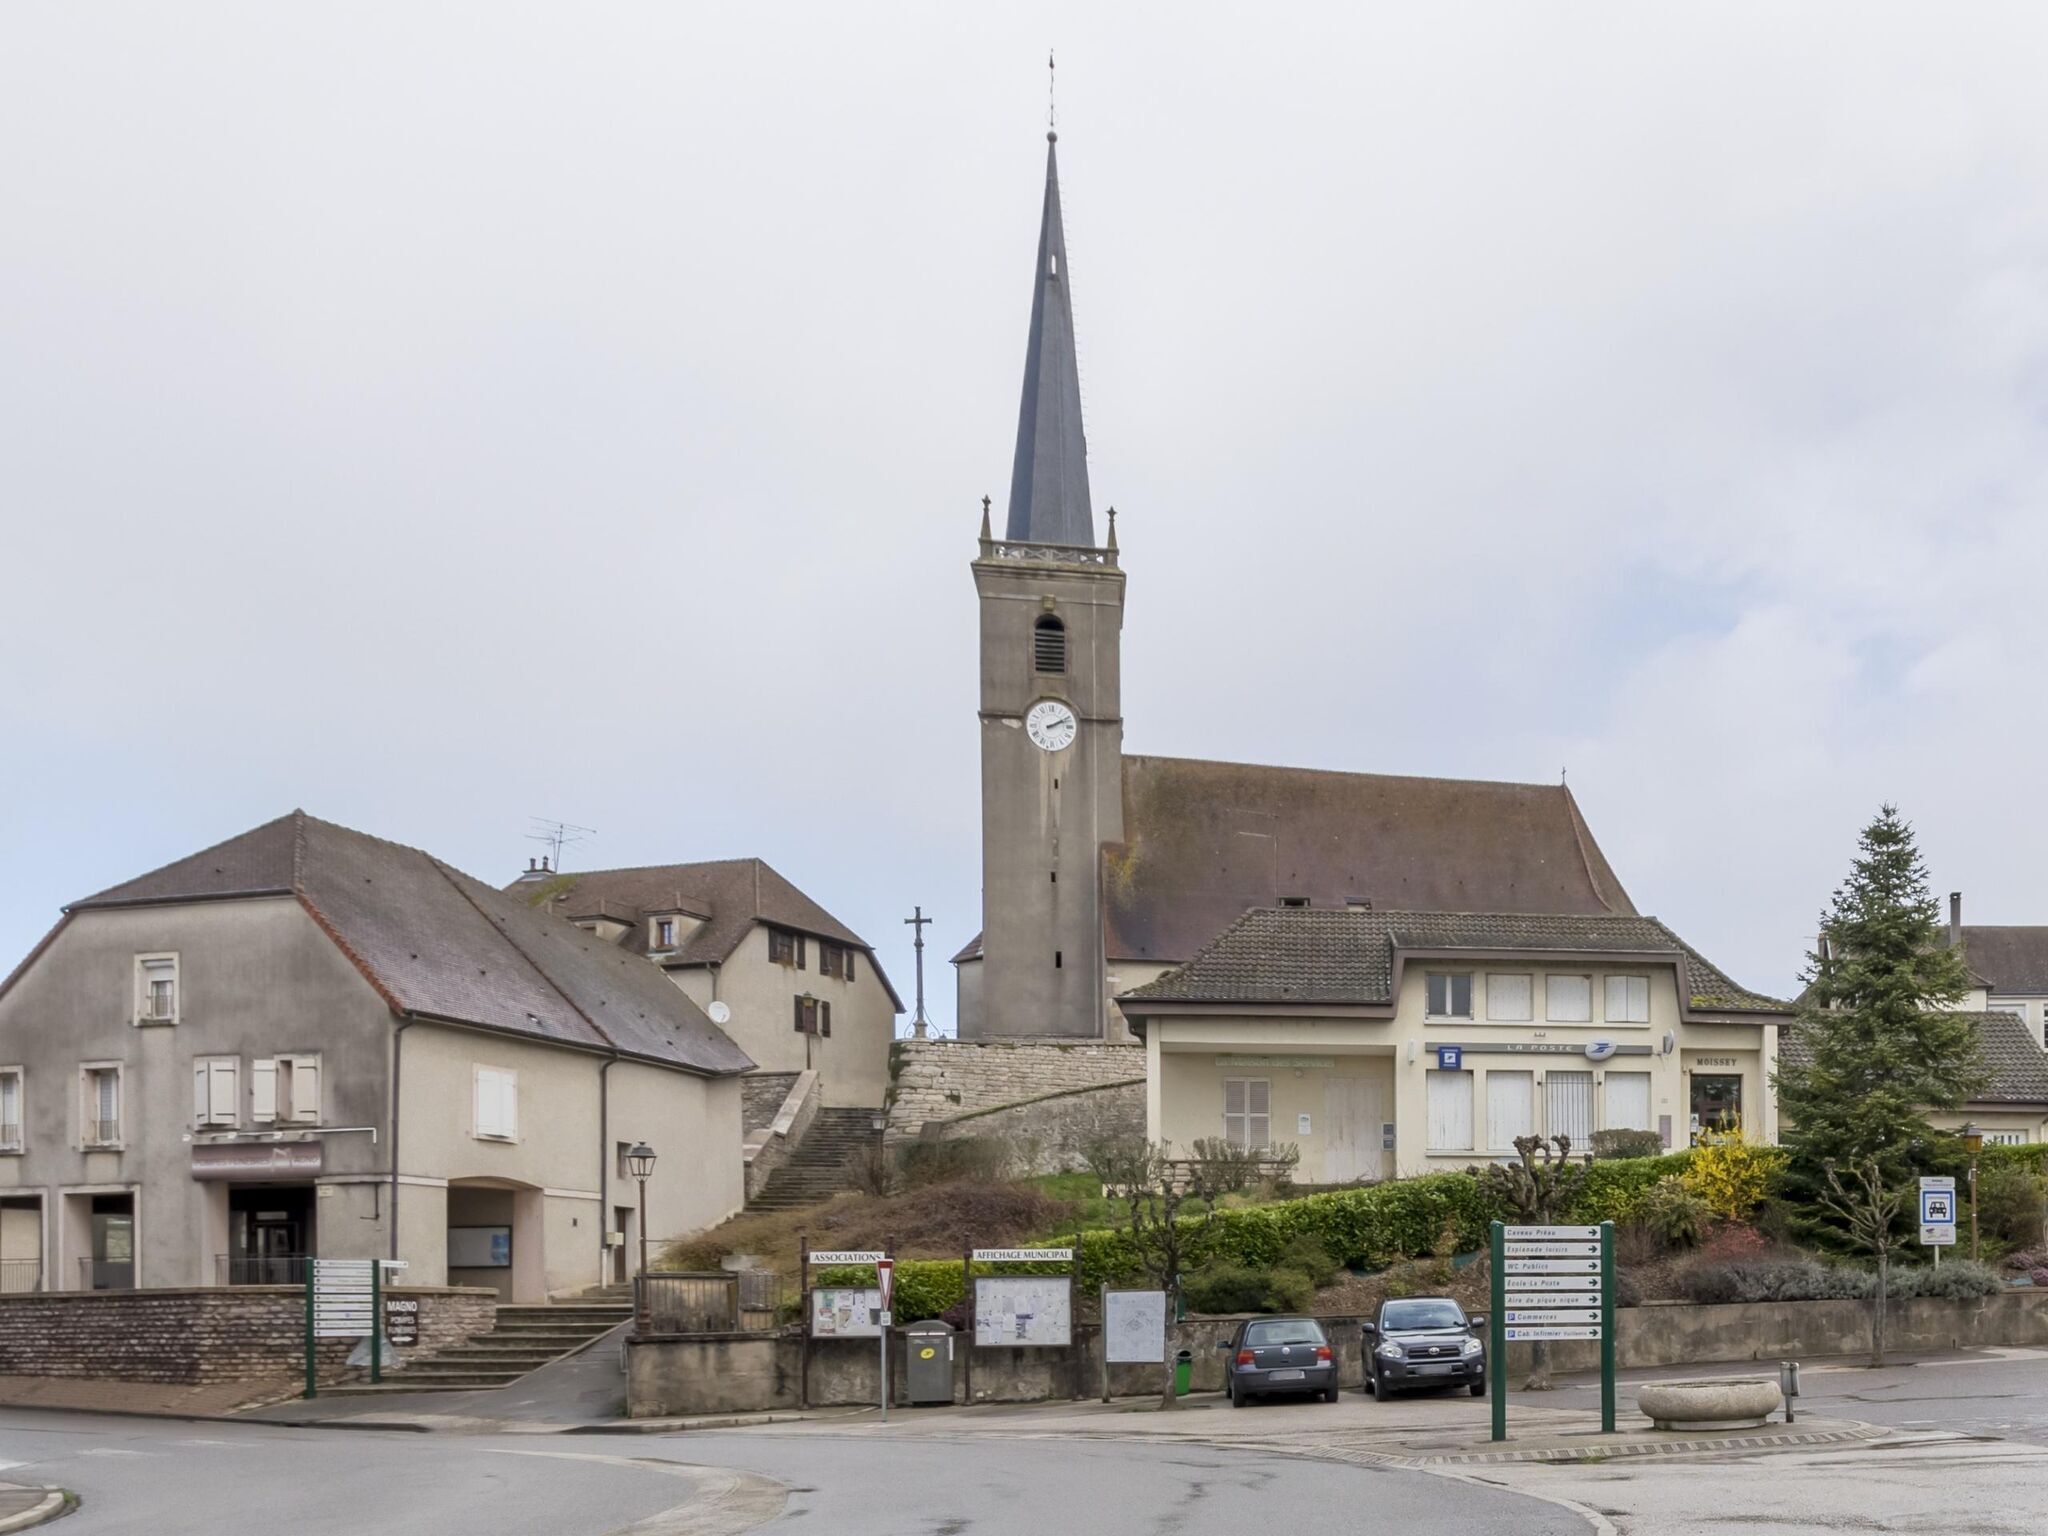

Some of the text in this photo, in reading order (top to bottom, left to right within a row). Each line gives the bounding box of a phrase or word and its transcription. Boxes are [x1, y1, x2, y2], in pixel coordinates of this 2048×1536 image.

[1697, 1058, 1737, 1066] MOISSEY
[1507, 1246, 1542, 1254] Esplanade
[814, 1253, 881, 1262] ASSOCIATIONS
[977, 1251, 1021, 1259] AFFICHAGE
[387, 1301, 417, 1311] MAGNO
